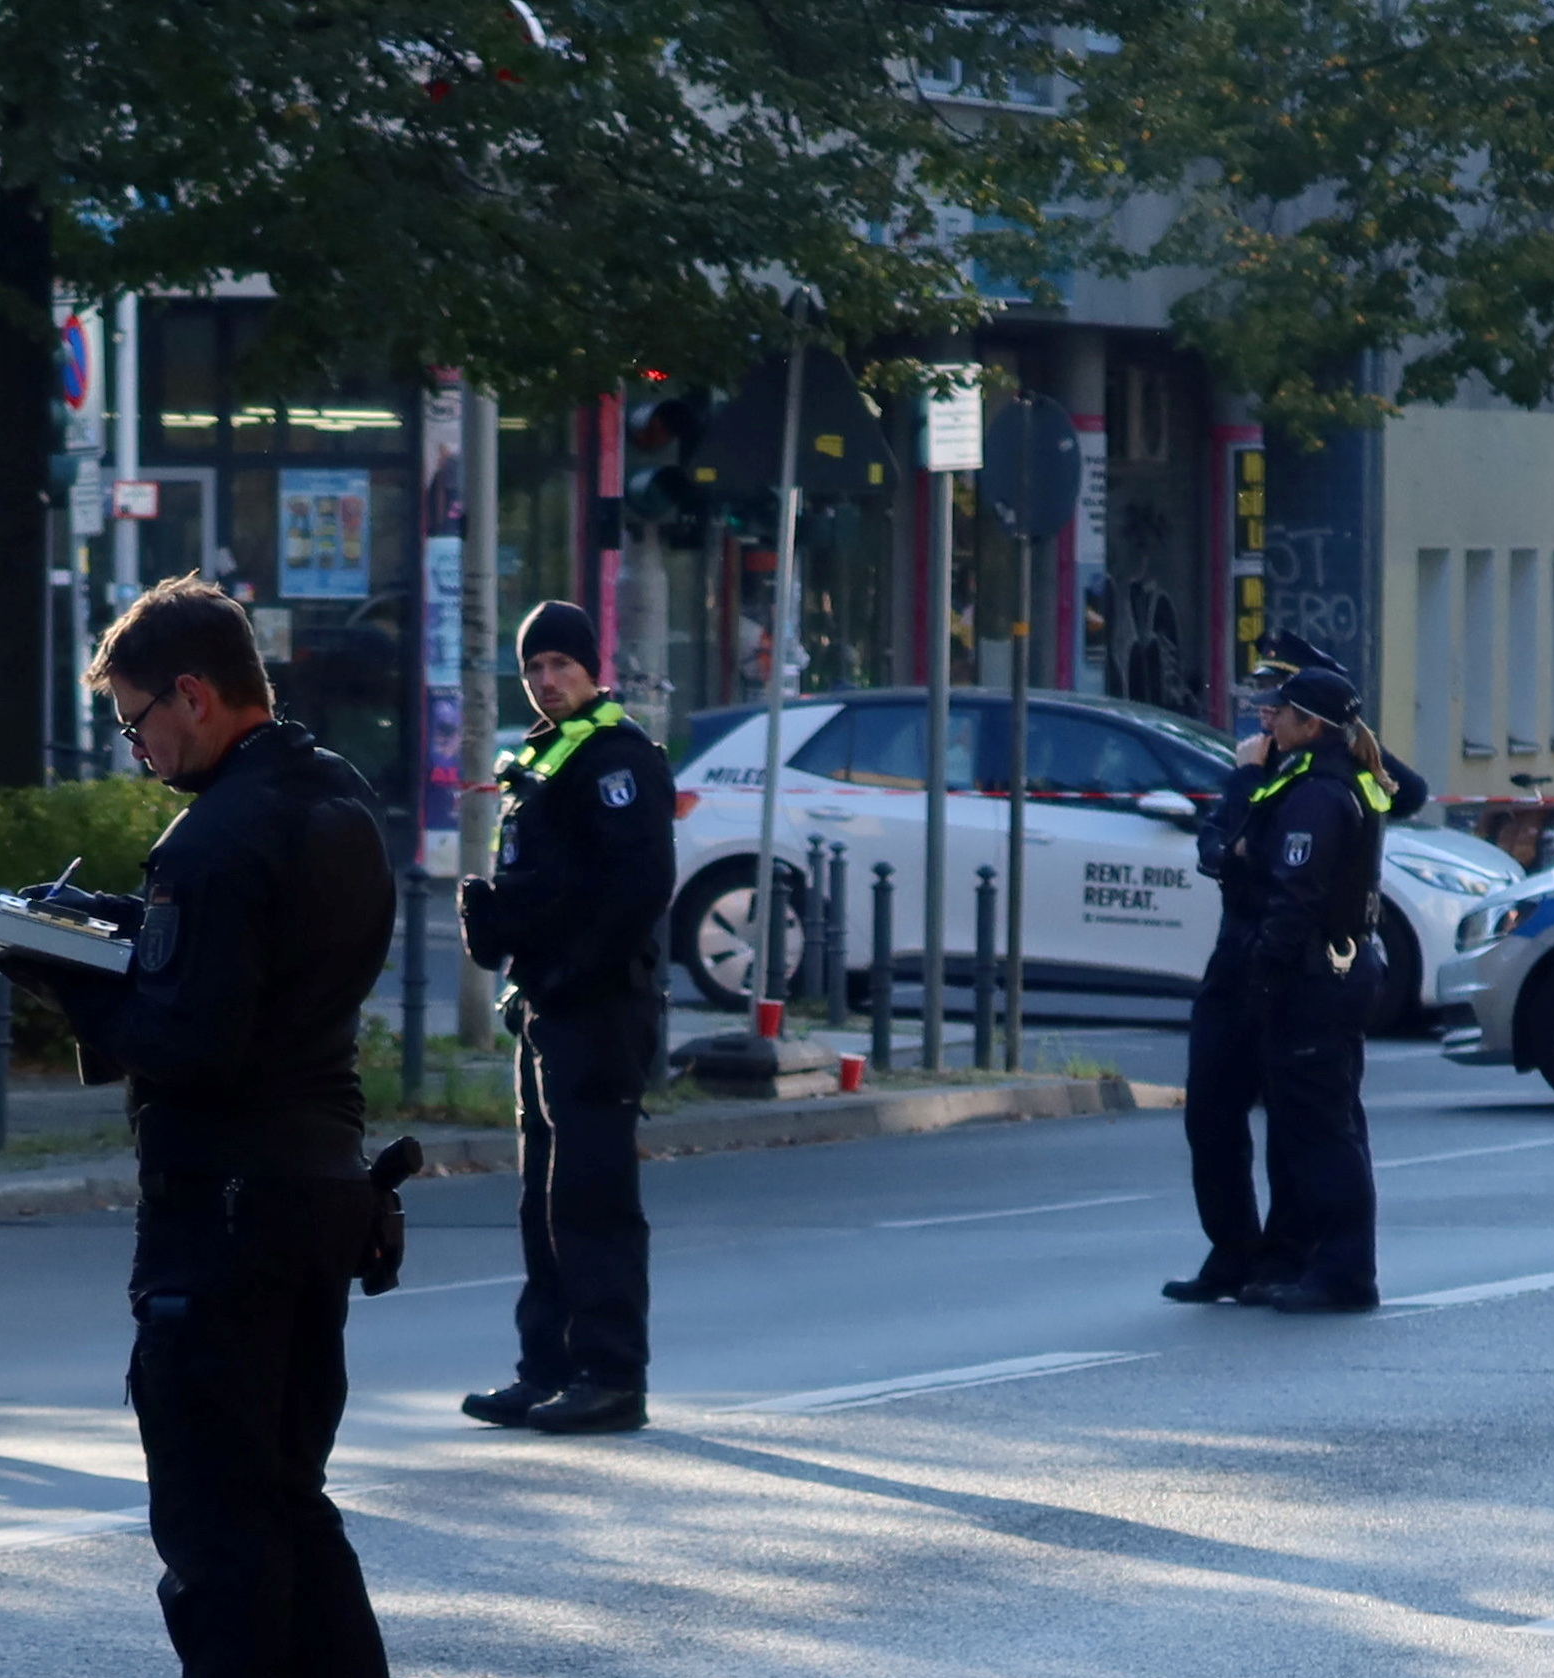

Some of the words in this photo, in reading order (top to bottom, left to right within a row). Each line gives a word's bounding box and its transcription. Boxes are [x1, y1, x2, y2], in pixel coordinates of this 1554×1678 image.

[1084, 862, 1137, 885] RENT.
[1142, 865, 1193, 889] RIDE.
[1083, 886, 1159, 911] REPEAT.
